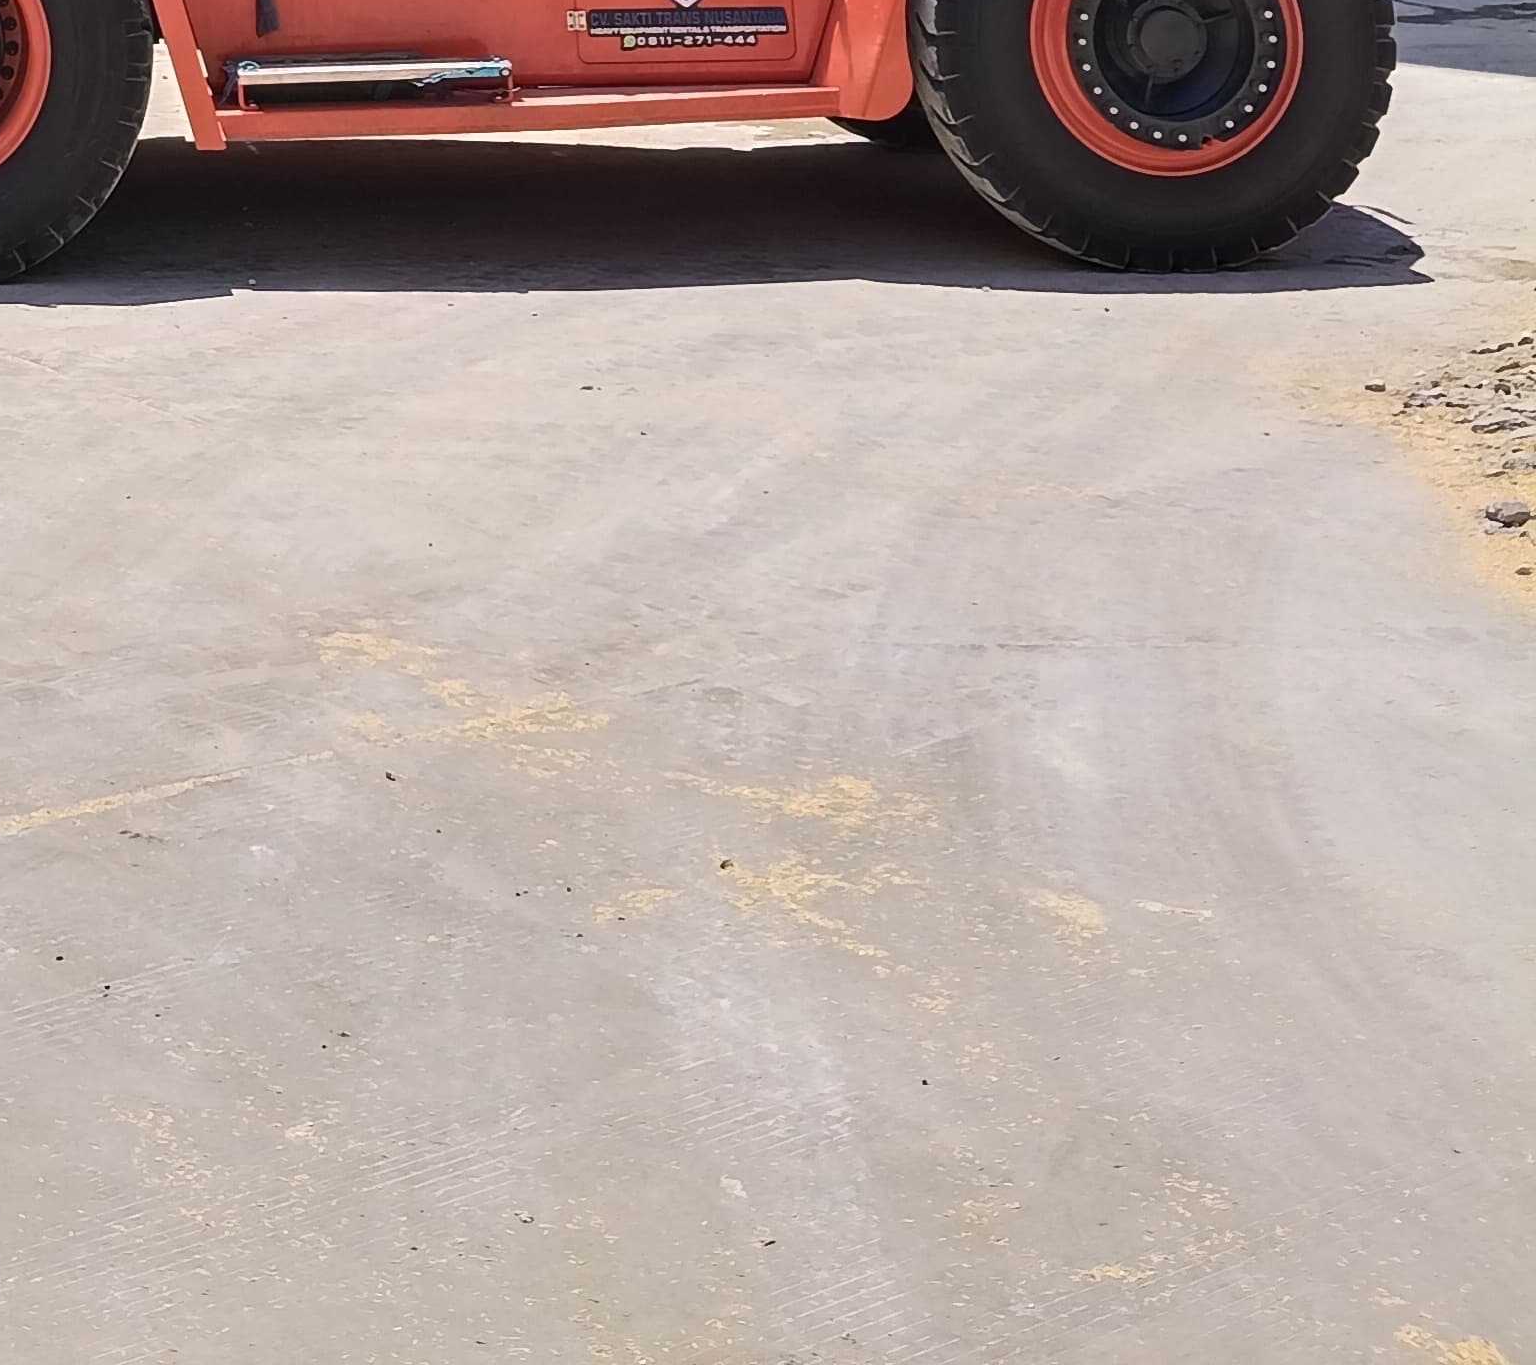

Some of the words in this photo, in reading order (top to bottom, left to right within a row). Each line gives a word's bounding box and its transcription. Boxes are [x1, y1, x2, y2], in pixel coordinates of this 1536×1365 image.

[590, 12, 611, 27] CV.
[615, 12, 652, 26] SAKTI
[656, 11, 700, 25] TRANS
[637, 34, 757, 46] 0811-271-444
